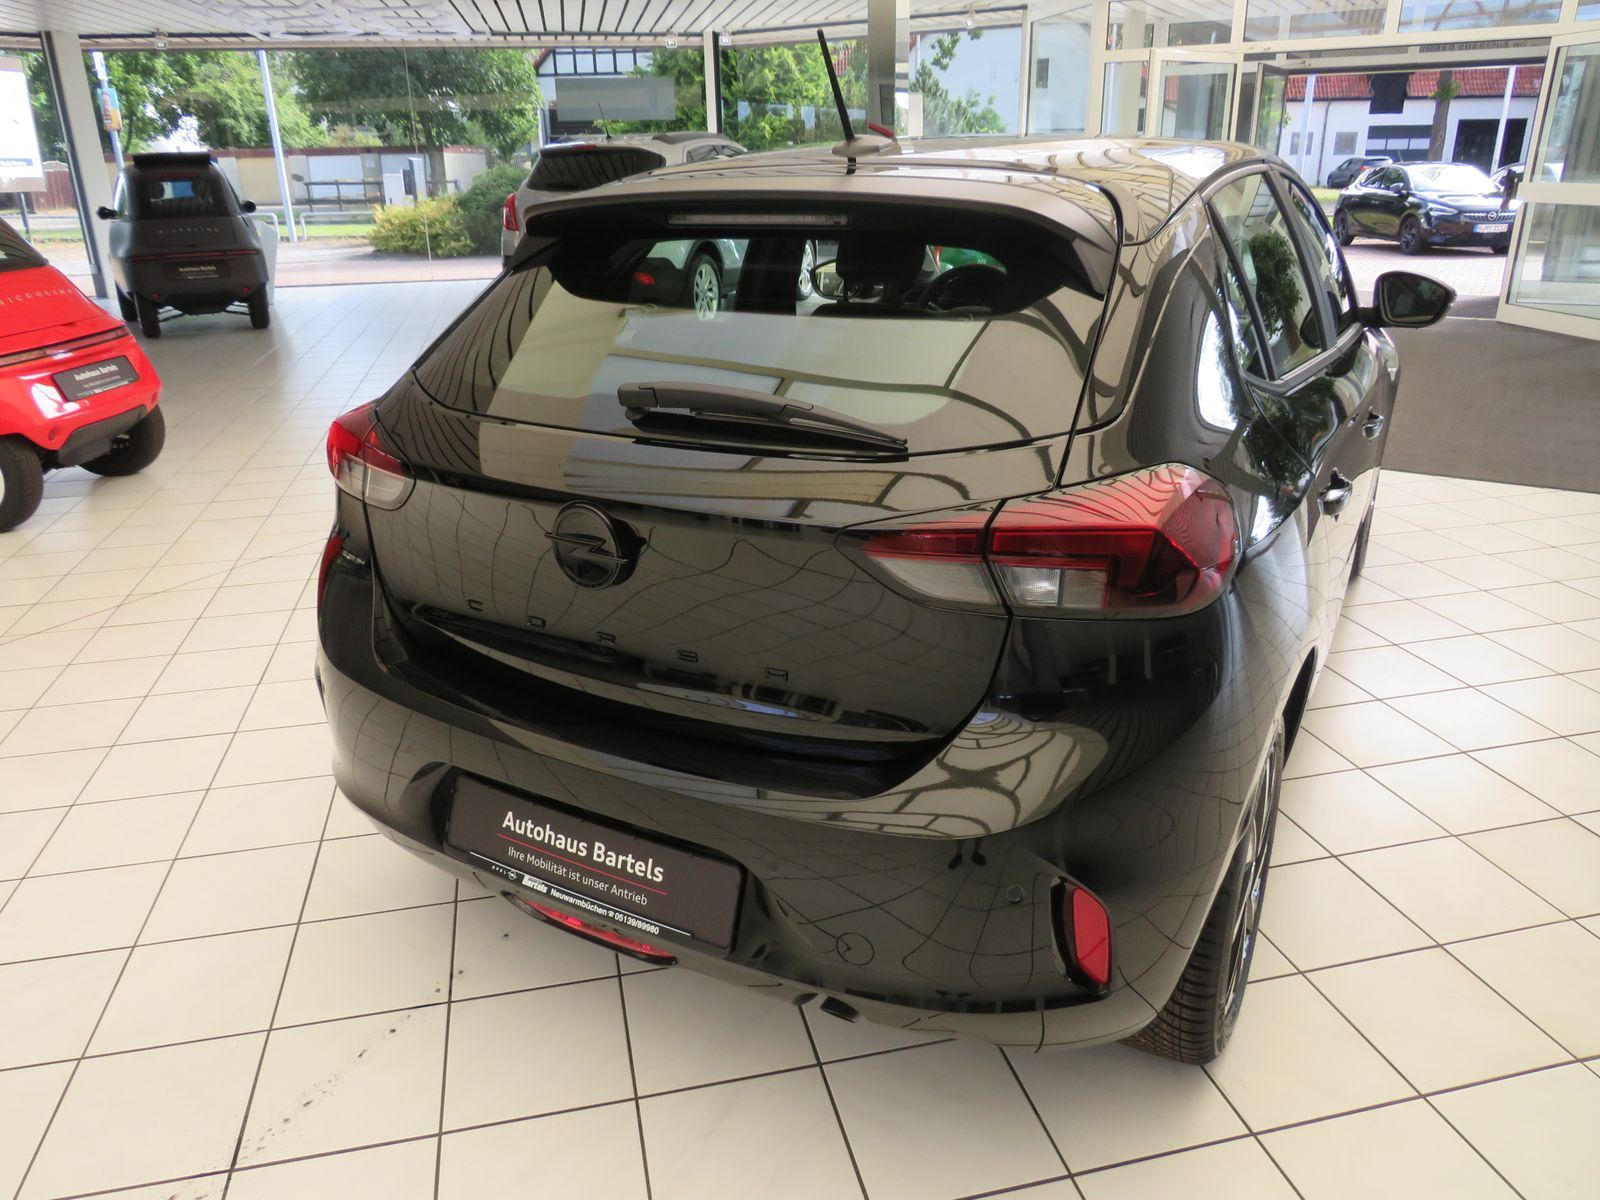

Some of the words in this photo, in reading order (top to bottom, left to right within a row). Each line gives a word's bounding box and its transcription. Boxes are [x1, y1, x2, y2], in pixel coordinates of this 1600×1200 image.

[502, 811, 588, 857] Autohaus
[592, 841, 664, 883] Bartels
[508, 846, 525, 861] Ihre
[526, 853, 567, 877] Mobilität
[568, 868, 580, 882] ist
[582, 876, 609, 892] unser
[611, 884, 648, 906] Antrieb
[550, 888, 608, 917] Neuwarmbüchen
